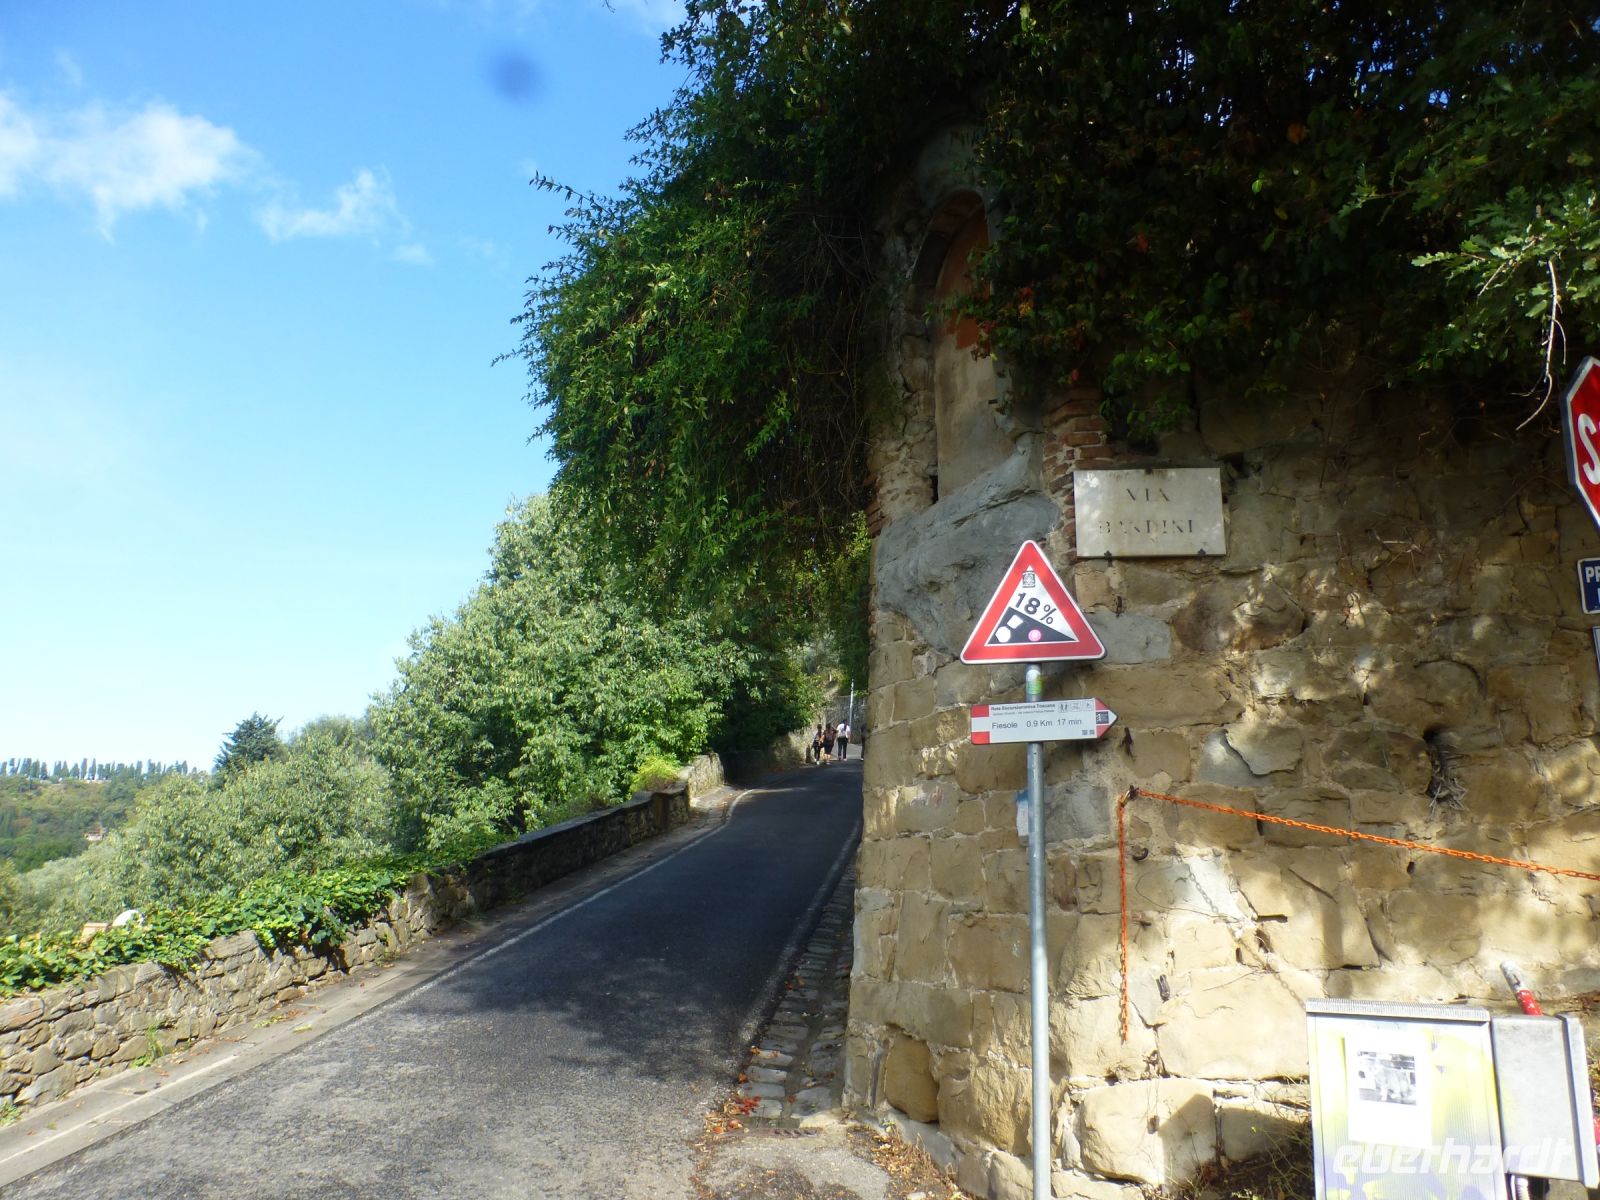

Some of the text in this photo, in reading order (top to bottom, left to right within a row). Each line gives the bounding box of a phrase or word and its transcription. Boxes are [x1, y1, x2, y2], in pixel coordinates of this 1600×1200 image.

[1577, 413, 1600, 485] S
[1125, 487, 1170, 502] VIA
[1015, 592, 1057, 625] 18%
[1026, 720, 1038, 728] 0.9
[1039, 719, 1053, 727] Km
[1057, 718, 1066, 726] 17
